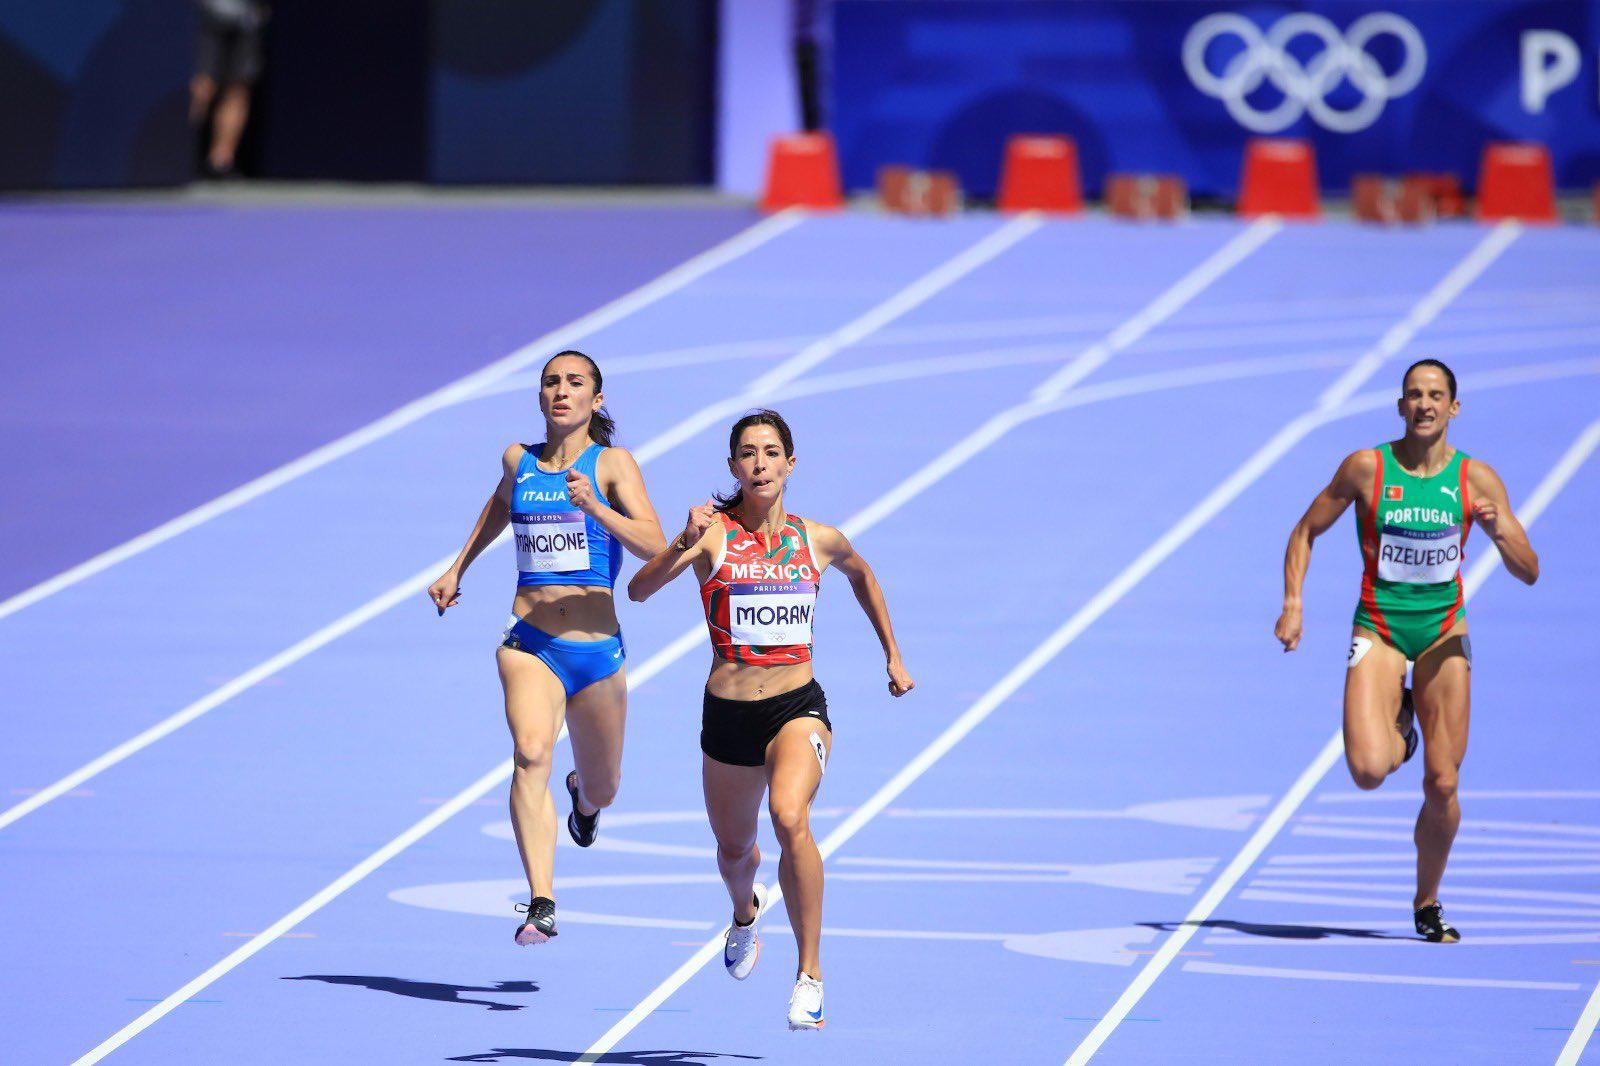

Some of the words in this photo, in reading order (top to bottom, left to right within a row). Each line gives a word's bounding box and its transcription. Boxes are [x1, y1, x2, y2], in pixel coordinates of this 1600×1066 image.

[522, 491, 567, 502] ITALIA
[1385, 507, 1455, 526] PORTUGAL
[515, 532, 586, 553] MANGIONE
[1382, 544, 1459, 566] AZEVEDO
[731, 558, 812, 580] MÉXICO
[736, 604, 811, 626] MORAN
